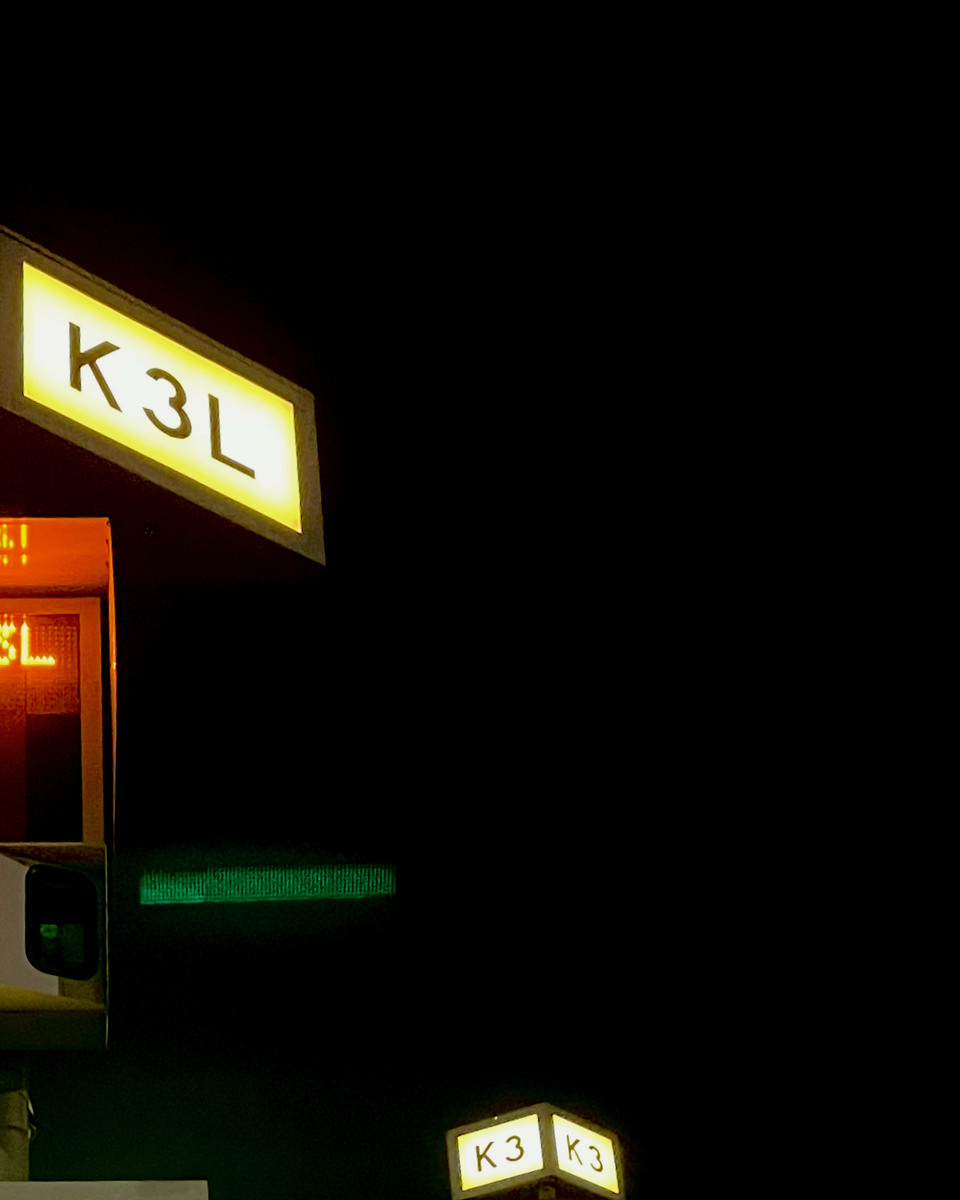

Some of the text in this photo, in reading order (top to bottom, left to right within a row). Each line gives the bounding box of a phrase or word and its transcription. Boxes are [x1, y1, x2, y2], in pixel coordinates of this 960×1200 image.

[69, 322, 256, 480] K3L
[475, 1135, 525, 1172] K3
[566, 1134, 604, 1173] K3
